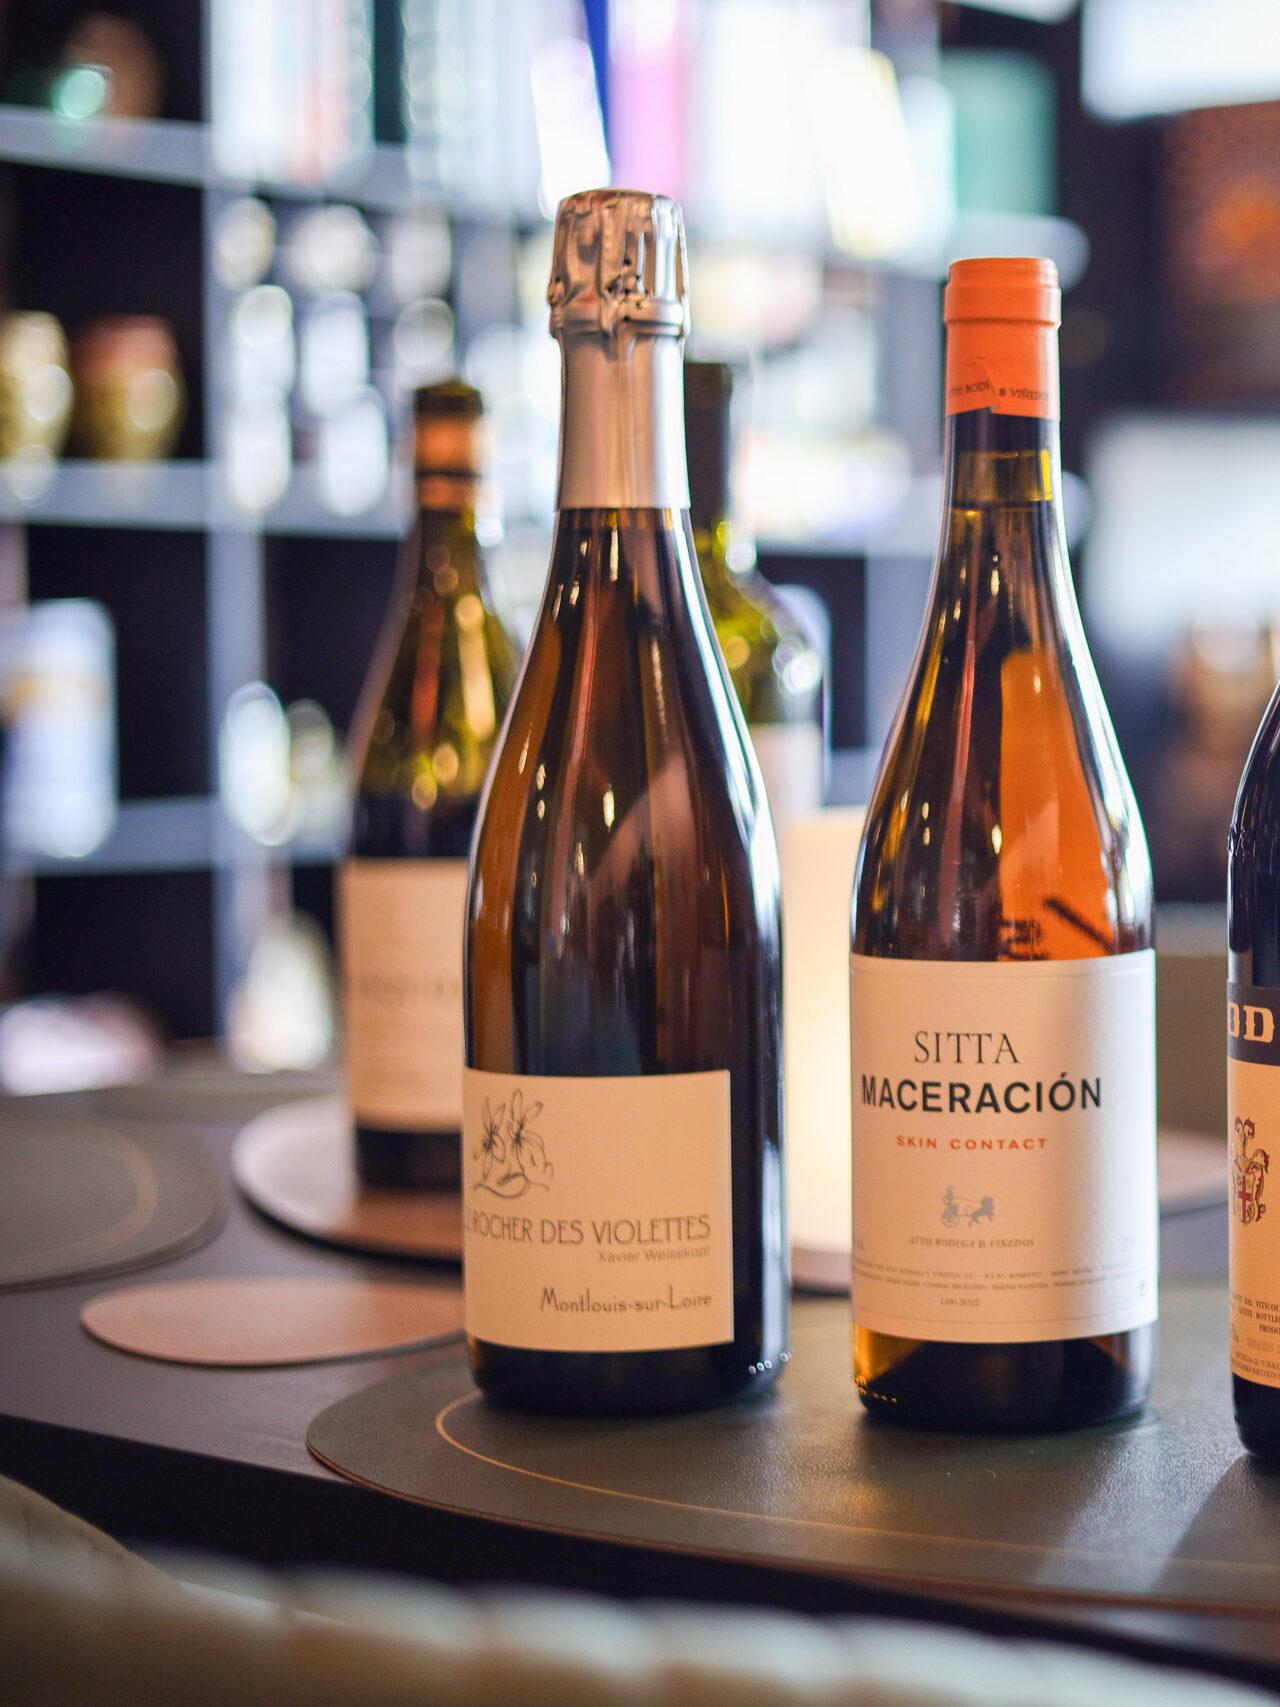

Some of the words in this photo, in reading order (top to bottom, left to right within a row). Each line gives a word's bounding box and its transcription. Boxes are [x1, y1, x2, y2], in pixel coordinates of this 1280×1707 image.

[914, 1030, 1020, 1064] SITTA
[862, 1072, 1101, 1114] MACERACIÓN
[896, 1135, 938, 1149] SKIN
[950, 1137, 1048, 1150] CONTACT
[472, 1209, 533, 1243] ROCHER
[540, 1218, 584, 1245] DES
[591, 1214, 712, 1245] VIOLETTES
[598, 1250, 640, 1264] Xavier
[541, 1285, 712, 1313] Montlouis-sur-Loire
